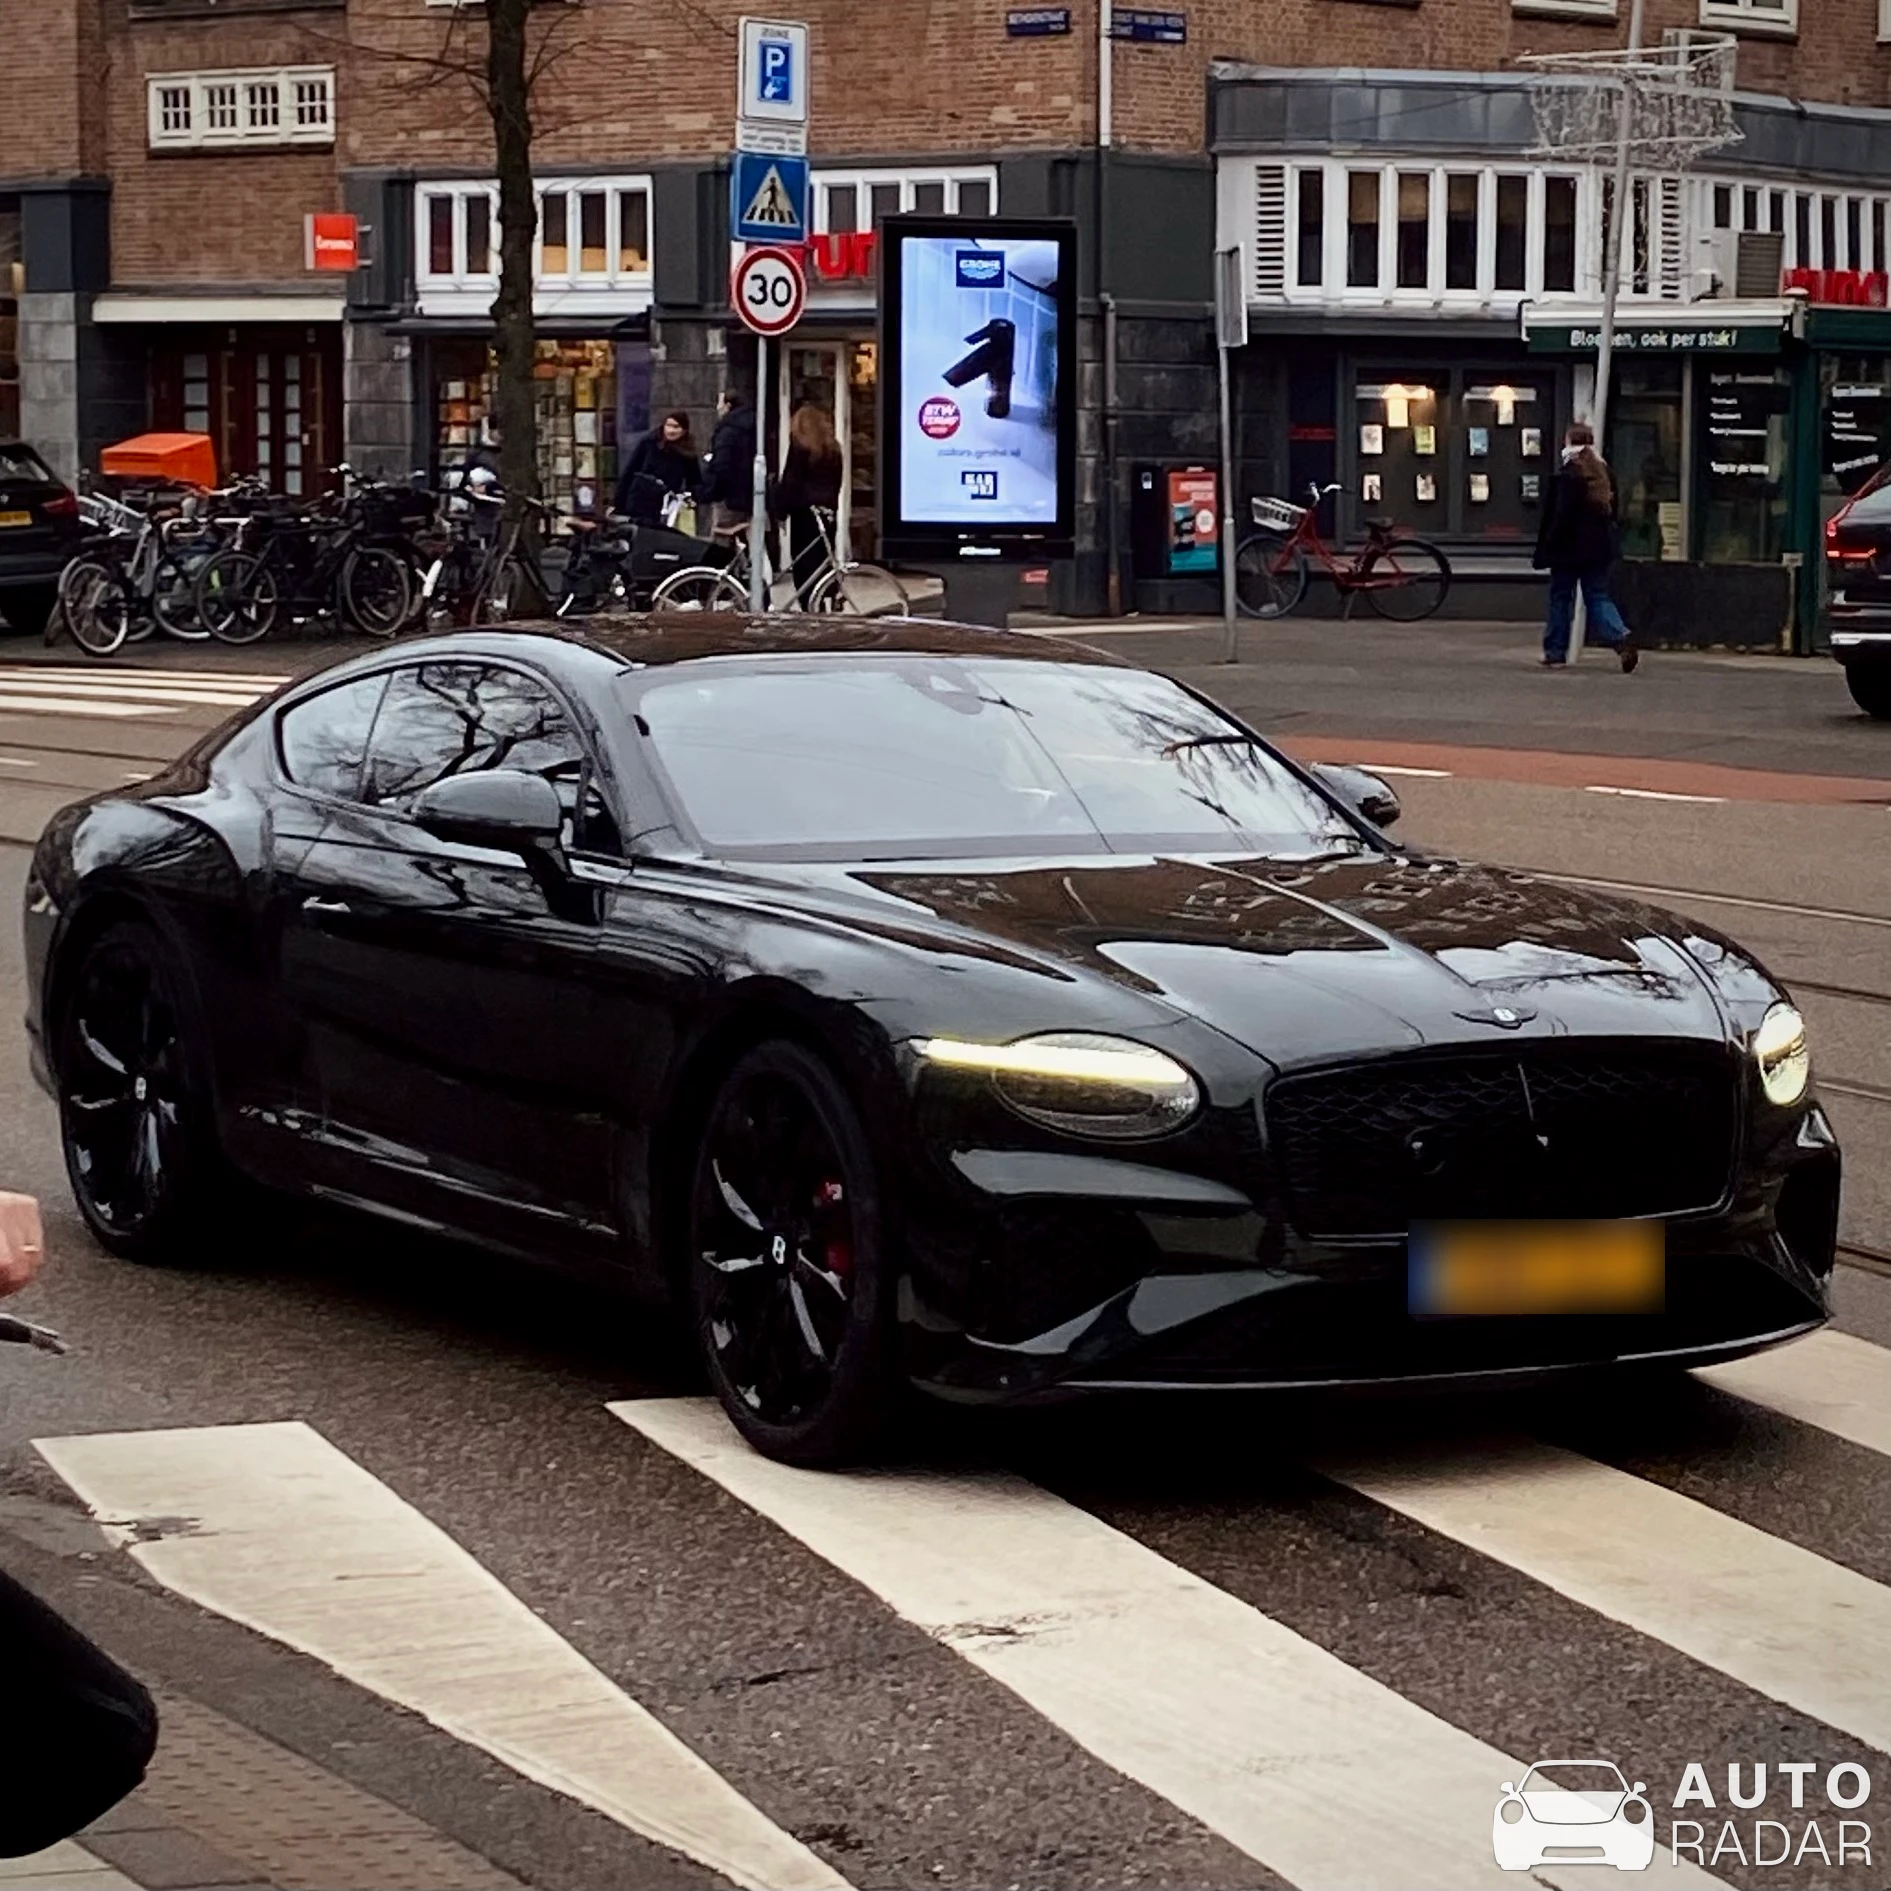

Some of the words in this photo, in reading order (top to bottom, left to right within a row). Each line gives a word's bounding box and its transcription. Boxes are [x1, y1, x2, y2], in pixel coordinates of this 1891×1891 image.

[766, 47, 786, 77] P
[748, 274, 792, 307] 30
[1641, 331, 1668, 346] ook
[1671, 333, 1697, 348] per
